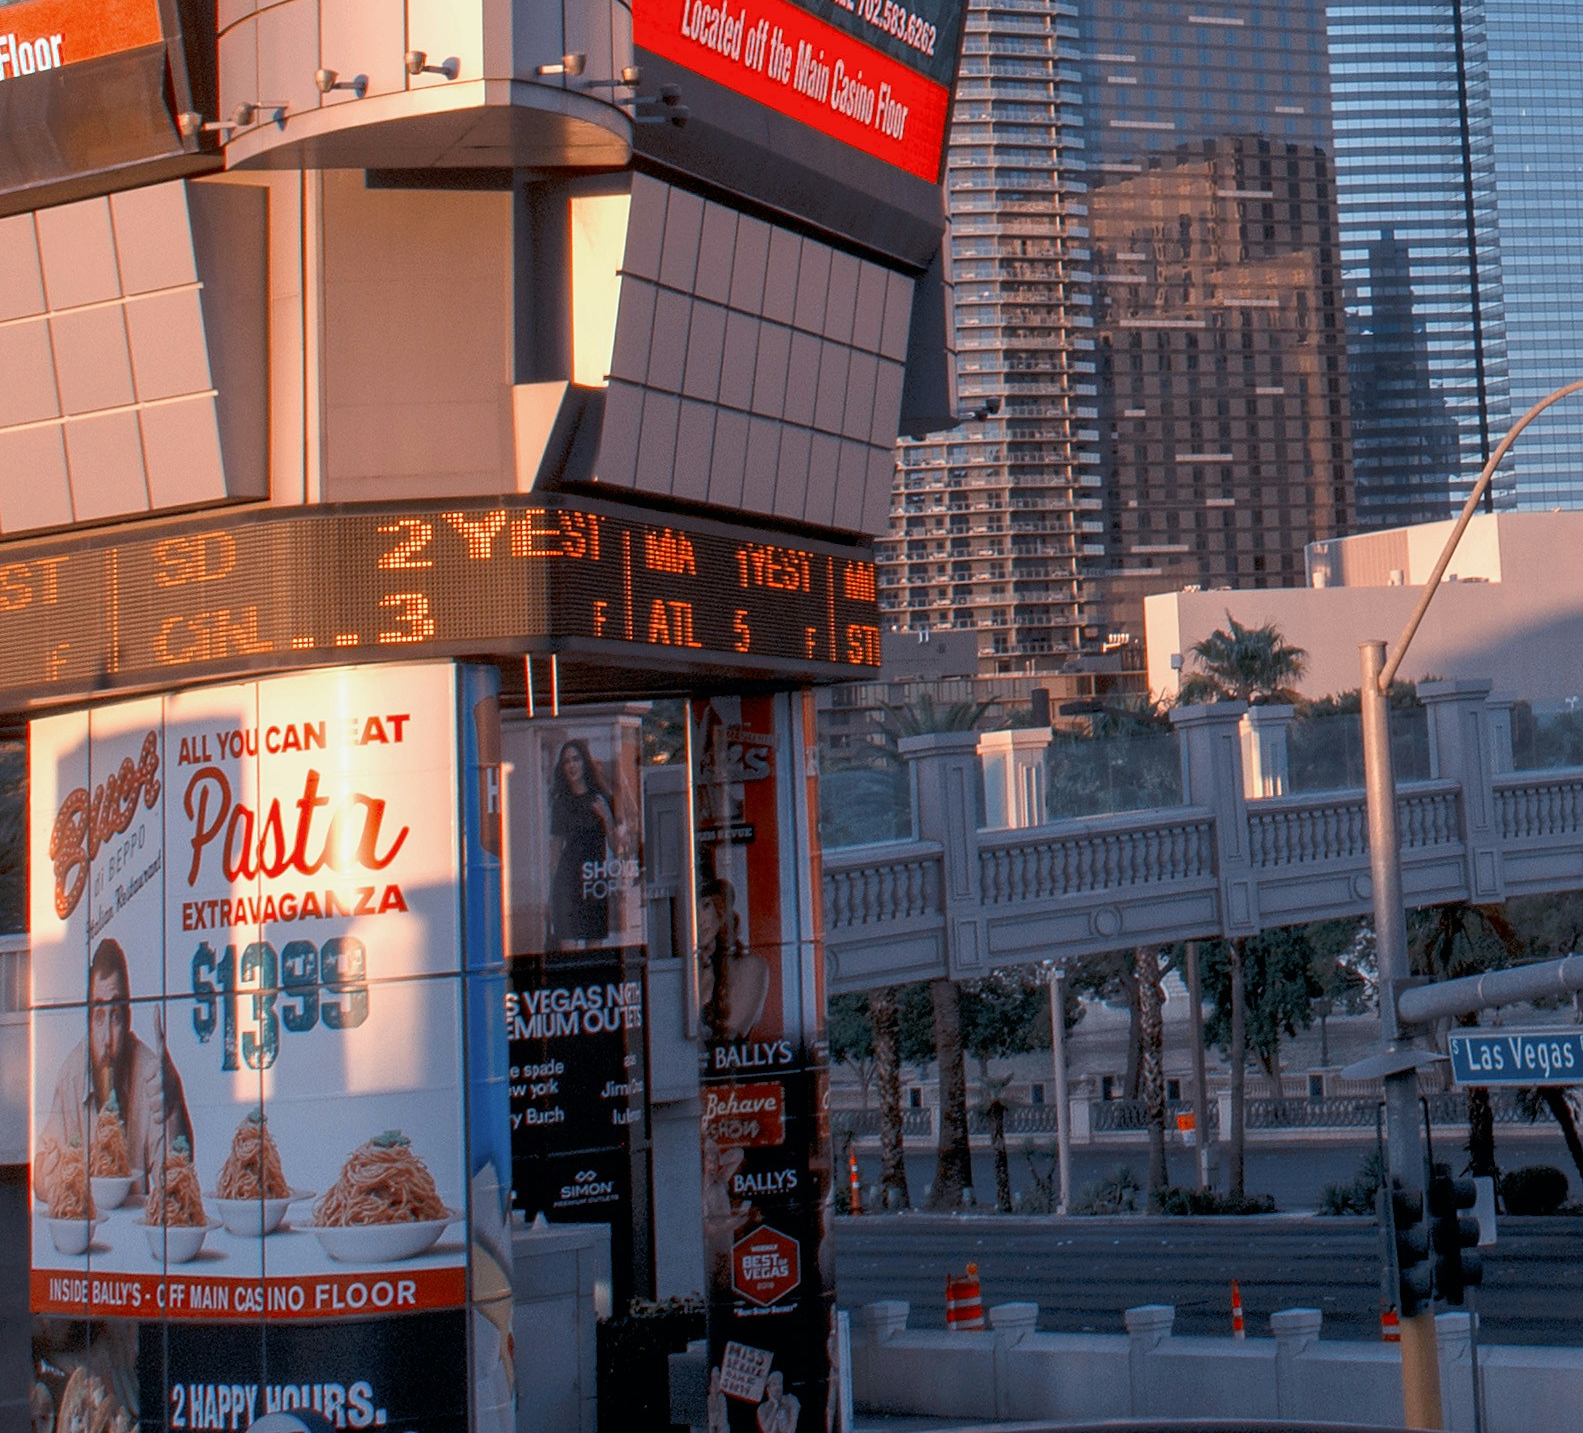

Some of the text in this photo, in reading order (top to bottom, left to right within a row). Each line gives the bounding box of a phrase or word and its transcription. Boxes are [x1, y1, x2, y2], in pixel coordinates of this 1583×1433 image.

[744, 18, 770, 72] off
[768, 25, 792, 85] the
[793, 39, 830, 103] Main
[830, 58, 875, 129] Casino
[875, 81, 908, 141] Floor
[151, 531, 236, 587] SD
[378, 592, 607, 643] 3 F
[648, 599, 702, 648] ATL
[46, 643, 70, 681] F
[178, 734, 212, 766] ALL
[217, 728, 258, 760] YOU
[265, 721, 327, 754] CAN
[184, 766, 410, 888] Pasta
[94, 823, 145, 898] di BEPPO
[182, 884, 409, 932] EXTRAVAGANZA
[523, 985, 603, 1015] VEGAS
[716, 1040, 793, 1069] BALLY'S
[1452, 1039, 1459, 1054] S
[1466, 1038, 1504, 1071] Las
[1508, 1036, 1574, 1078] Vegas
[561, 1181, 613, 1199] SIMON
[734, 1169, 798, 1193] BALLY'S
[742, 1253, 780, 1269] BEST
[743, 1266, 790, 1281] VEGAS
[49, 1278, 88, 1303] INSIDE
[92, 1279, 141, 1307] BALLY'S
[189, 1285, 229, 1311] MAIN
[235, 1285, 305, 1312] CASINO
[315, 1280, 417, 1309] FLOOR
[172, 1383, 186, 1427] 2
[189, 1383, 258, 1429] HAPPY
